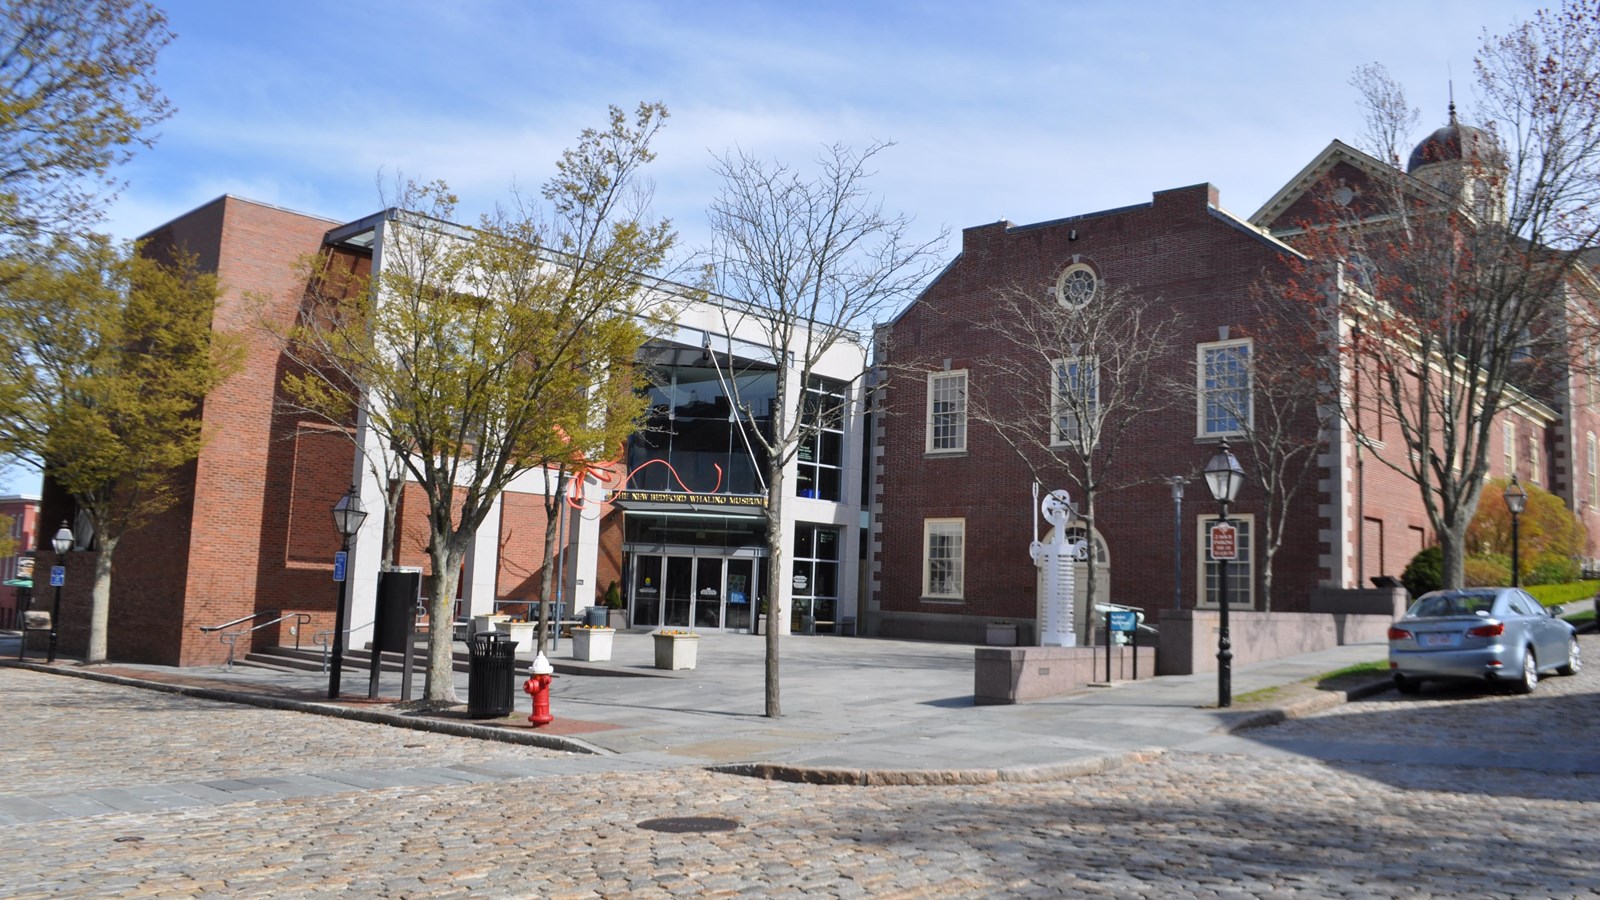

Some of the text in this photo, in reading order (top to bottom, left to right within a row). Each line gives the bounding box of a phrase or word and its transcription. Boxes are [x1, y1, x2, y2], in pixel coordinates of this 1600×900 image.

[632, 492, 649, 501] NEW
[650, 493, 687, 502] BEDFORD
[689, 495, 726, 504] WHALING
[729, 496, 763, 506] MUSEUM
